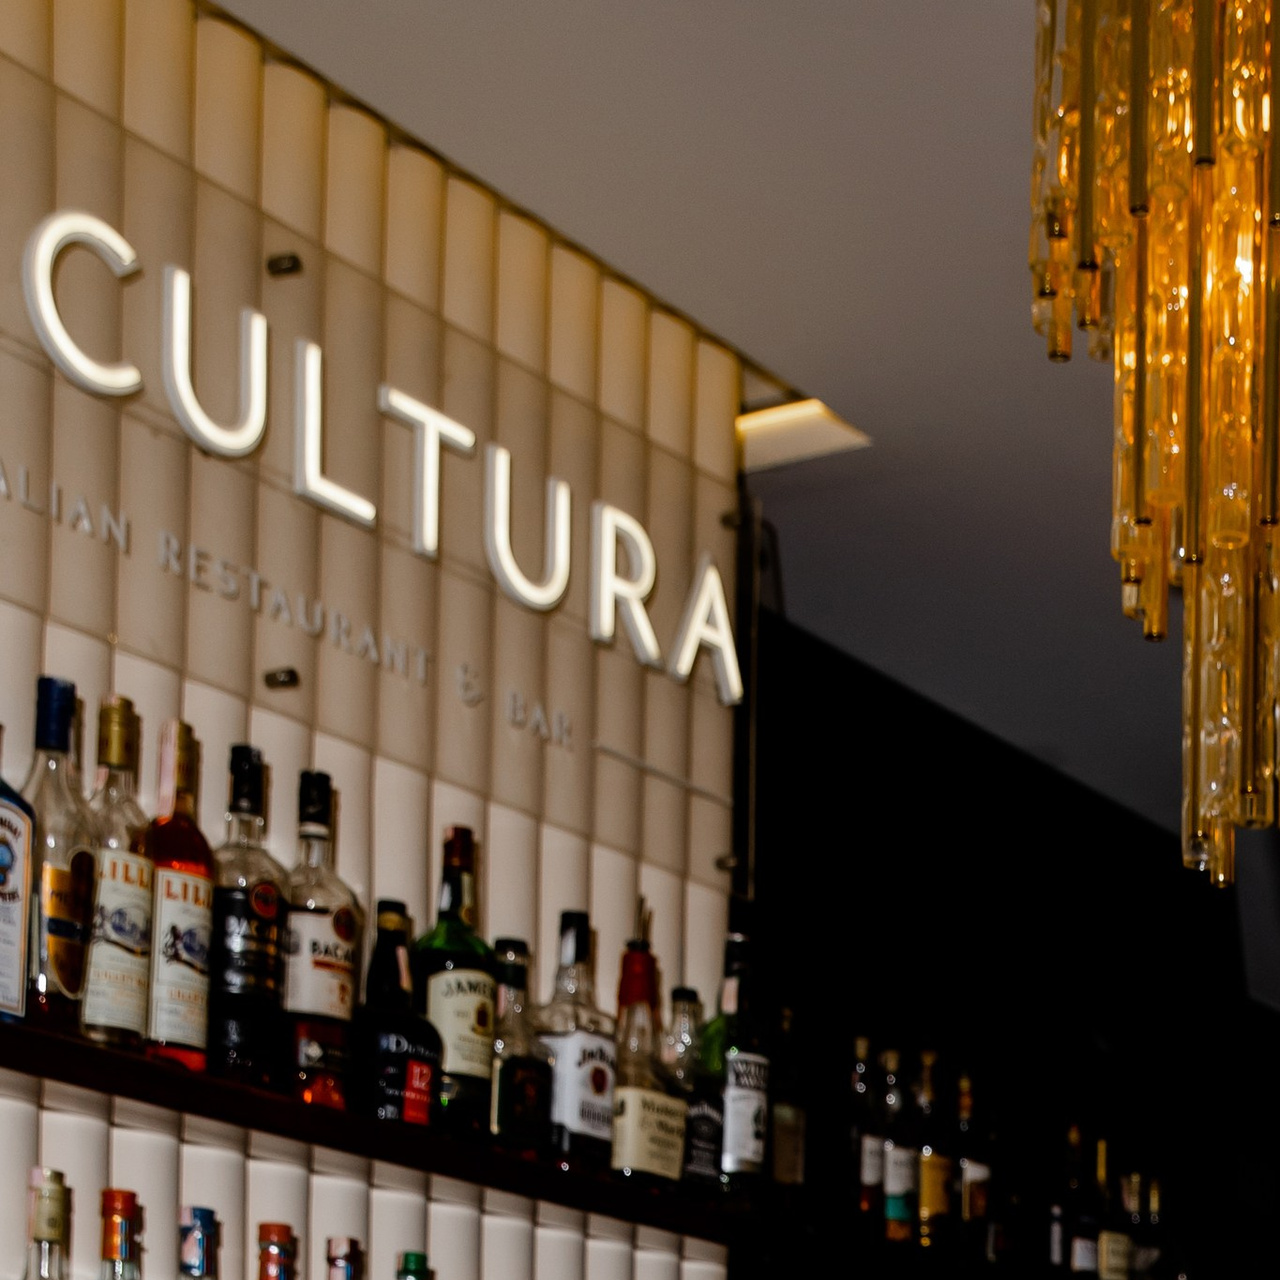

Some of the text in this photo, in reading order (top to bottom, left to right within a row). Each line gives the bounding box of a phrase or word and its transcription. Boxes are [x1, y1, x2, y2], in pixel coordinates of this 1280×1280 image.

[23, 211, 743, 705] CULTURA
[157, 528, 432, 685] RESTAURANT
[506, 689, 575, 748] BAR
